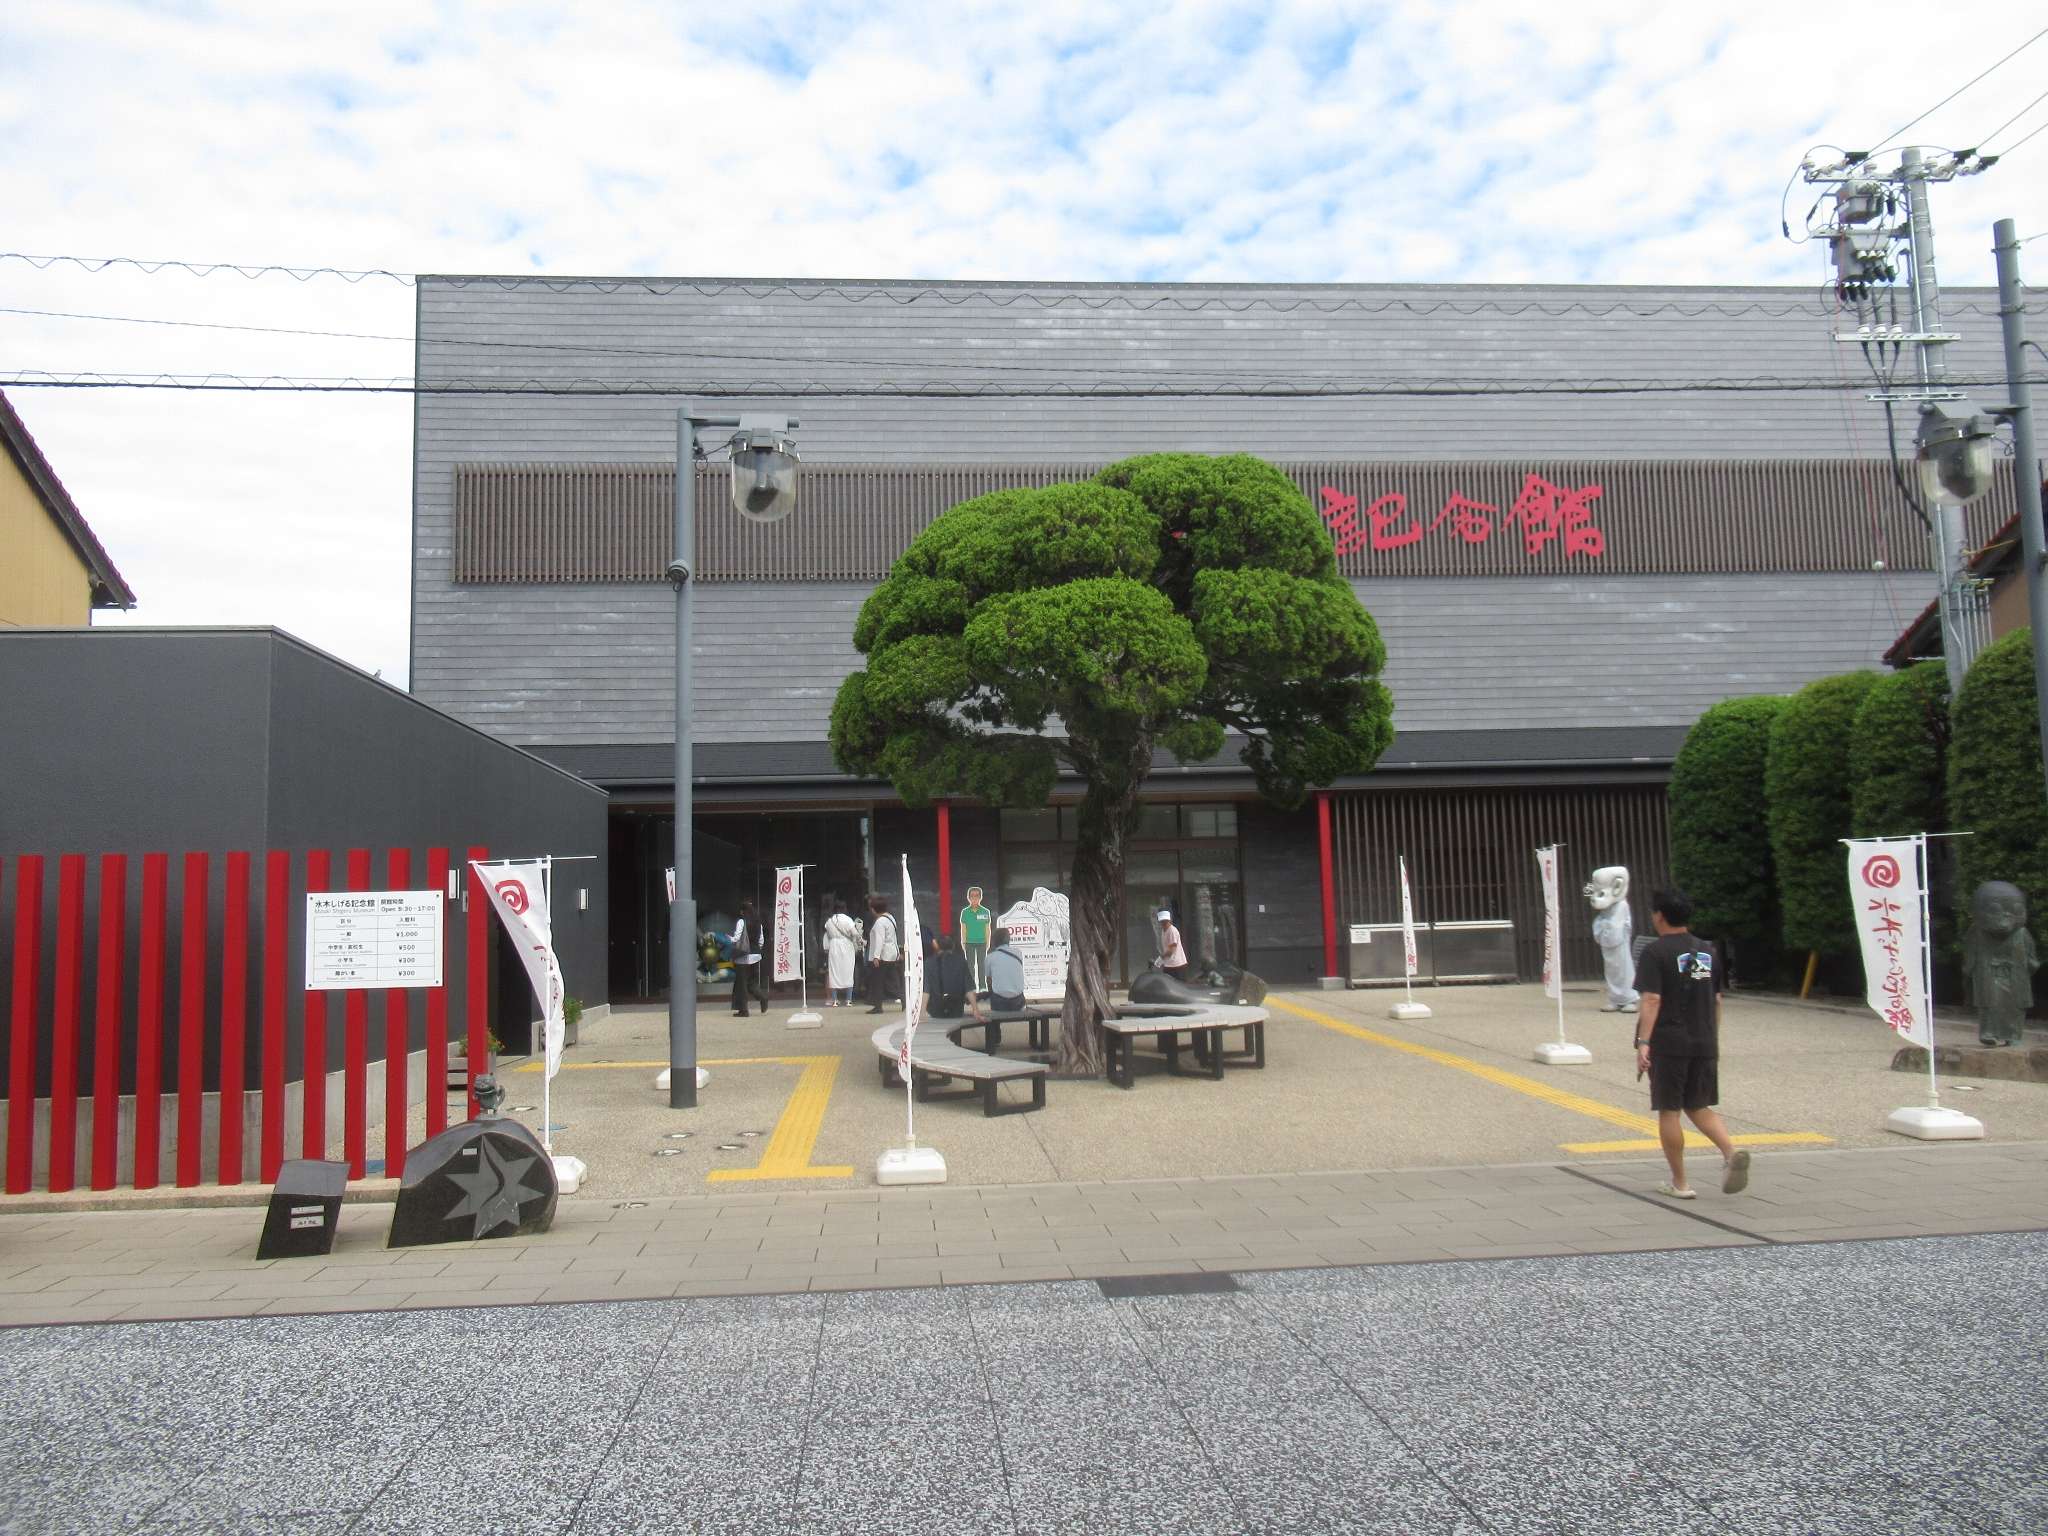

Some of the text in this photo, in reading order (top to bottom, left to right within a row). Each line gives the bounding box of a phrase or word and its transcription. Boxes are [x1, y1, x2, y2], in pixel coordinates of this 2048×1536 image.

[1320, 473, 1604, 559] 記念館
[315, 899, 375, 908] 水木しげる記念館
[1008, 926, 1038, 936] OPEN
